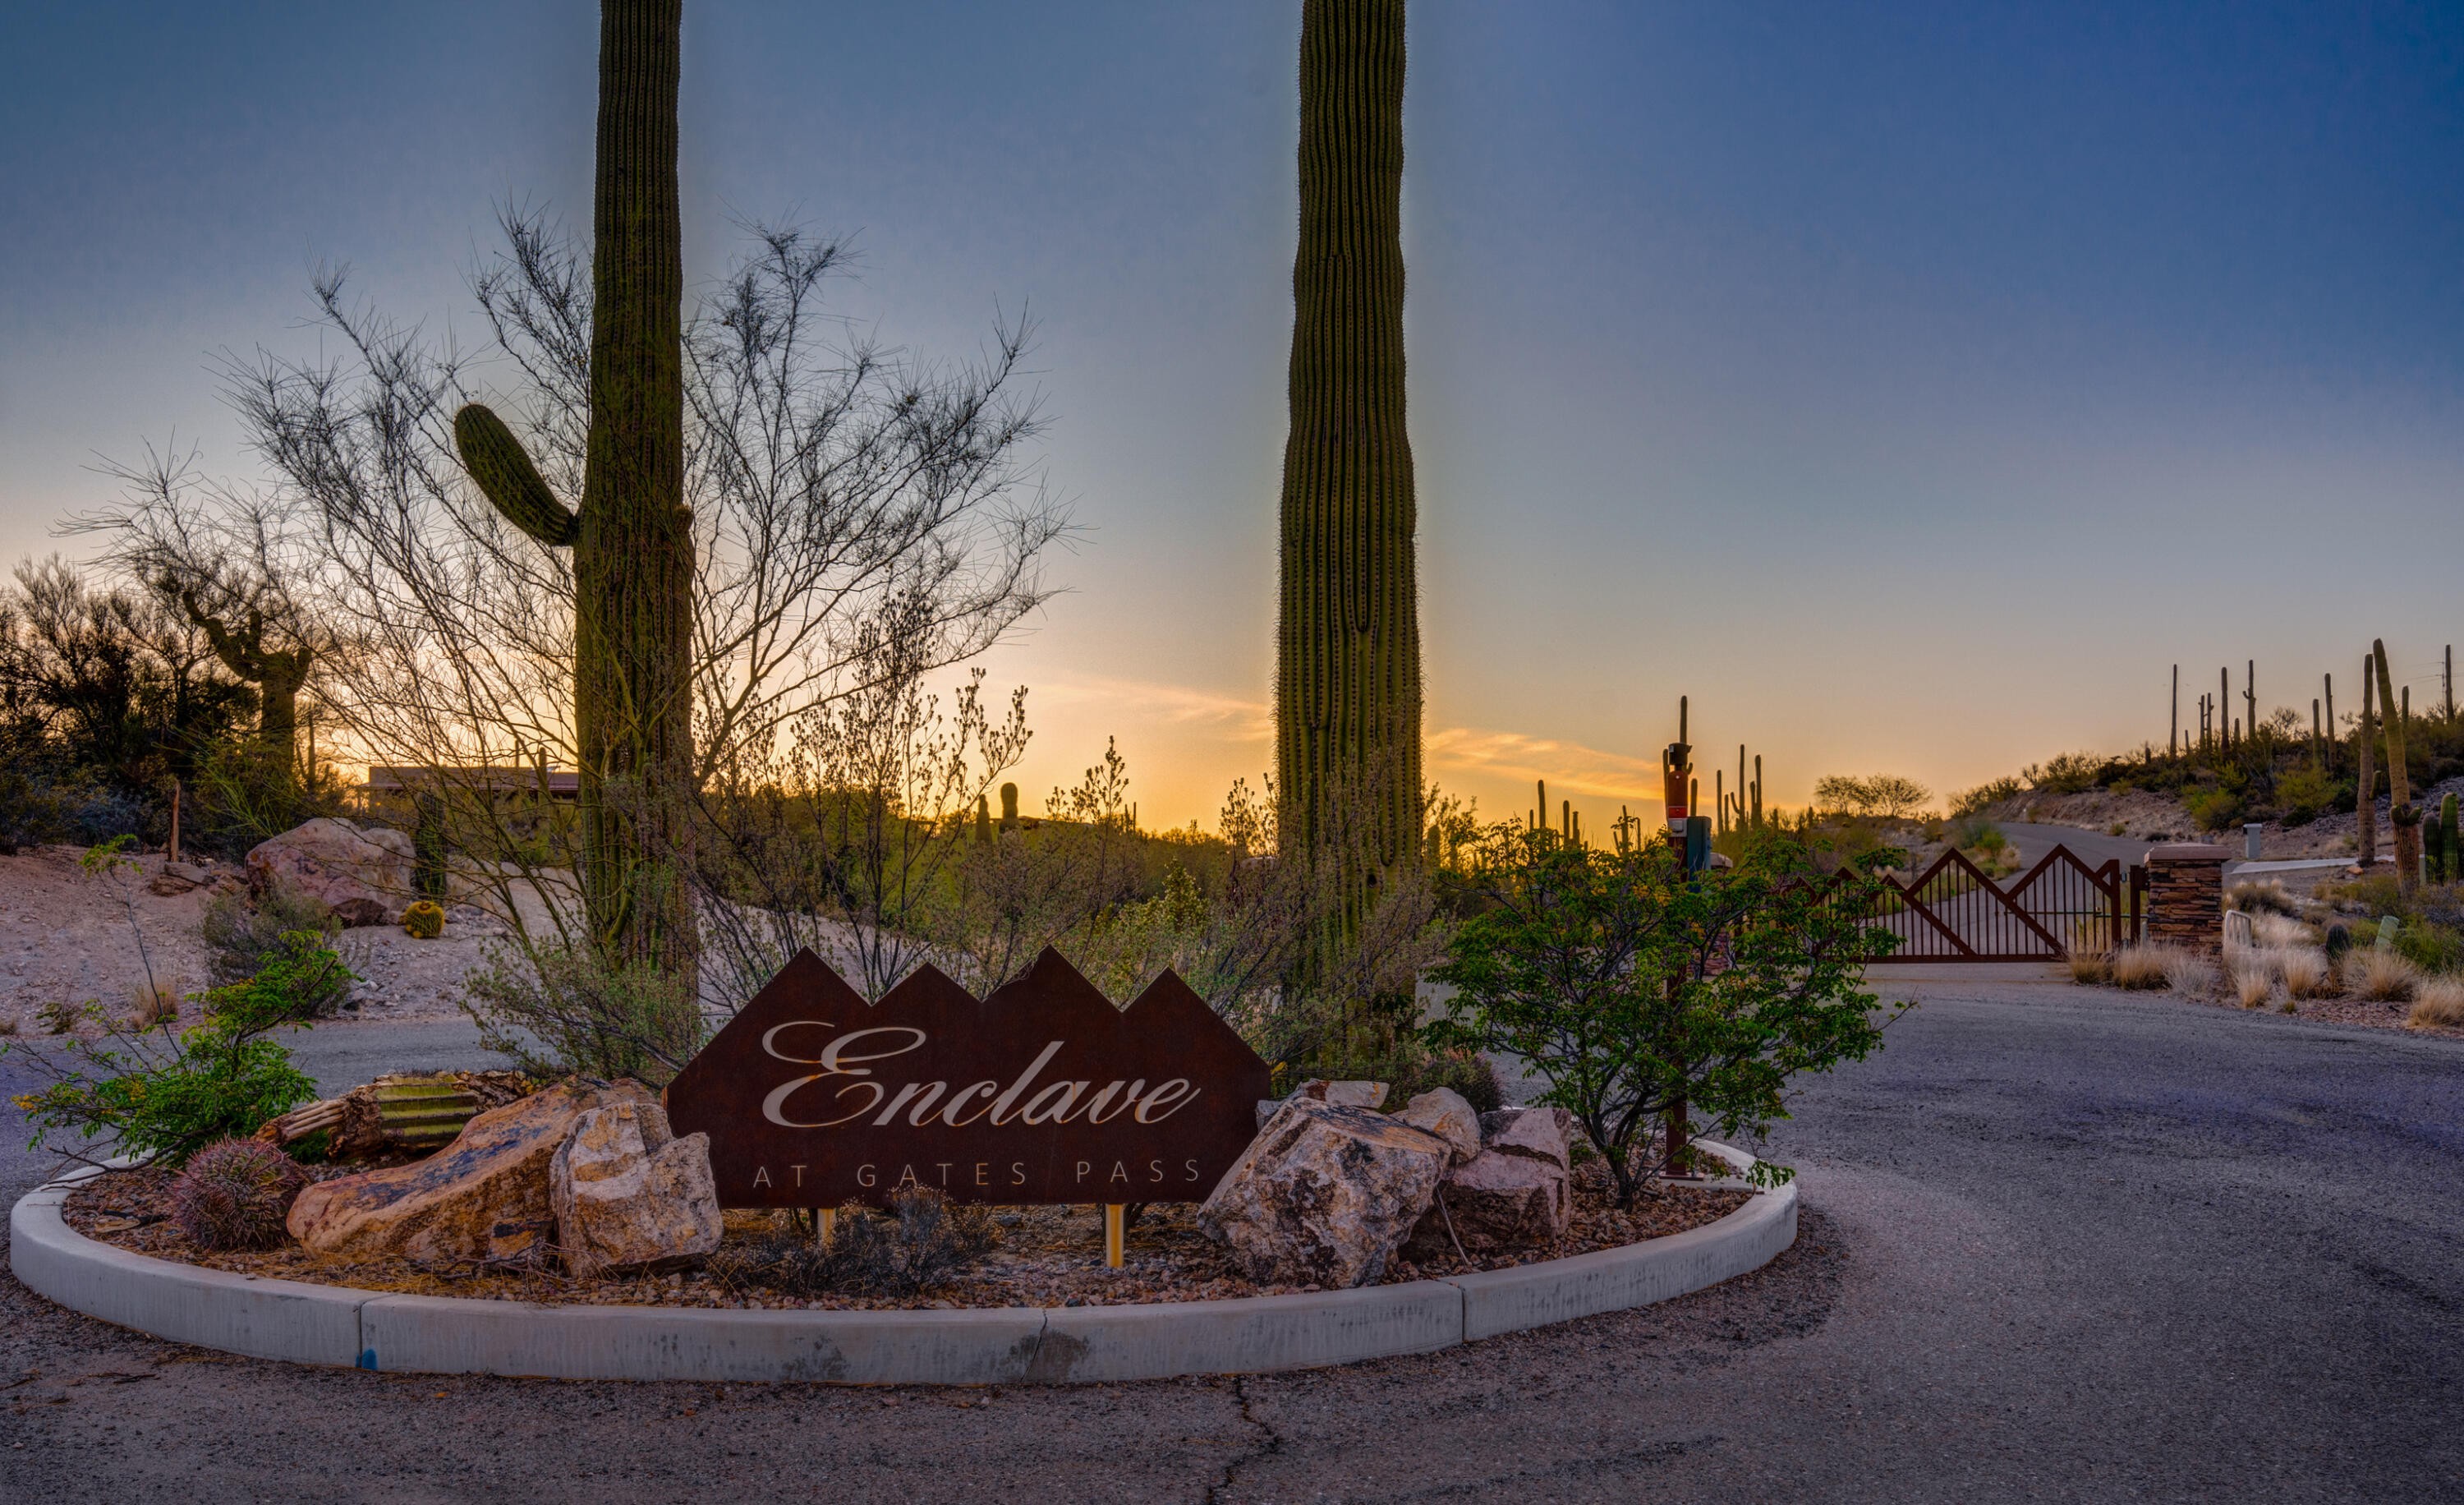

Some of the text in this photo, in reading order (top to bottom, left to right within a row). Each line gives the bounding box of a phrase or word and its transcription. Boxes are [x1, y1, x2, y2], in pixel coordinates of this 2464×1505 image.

[761, 1020, 1201, 1128] Enclave
[753, 1159, 1199, 1188] AT GATES PASS
